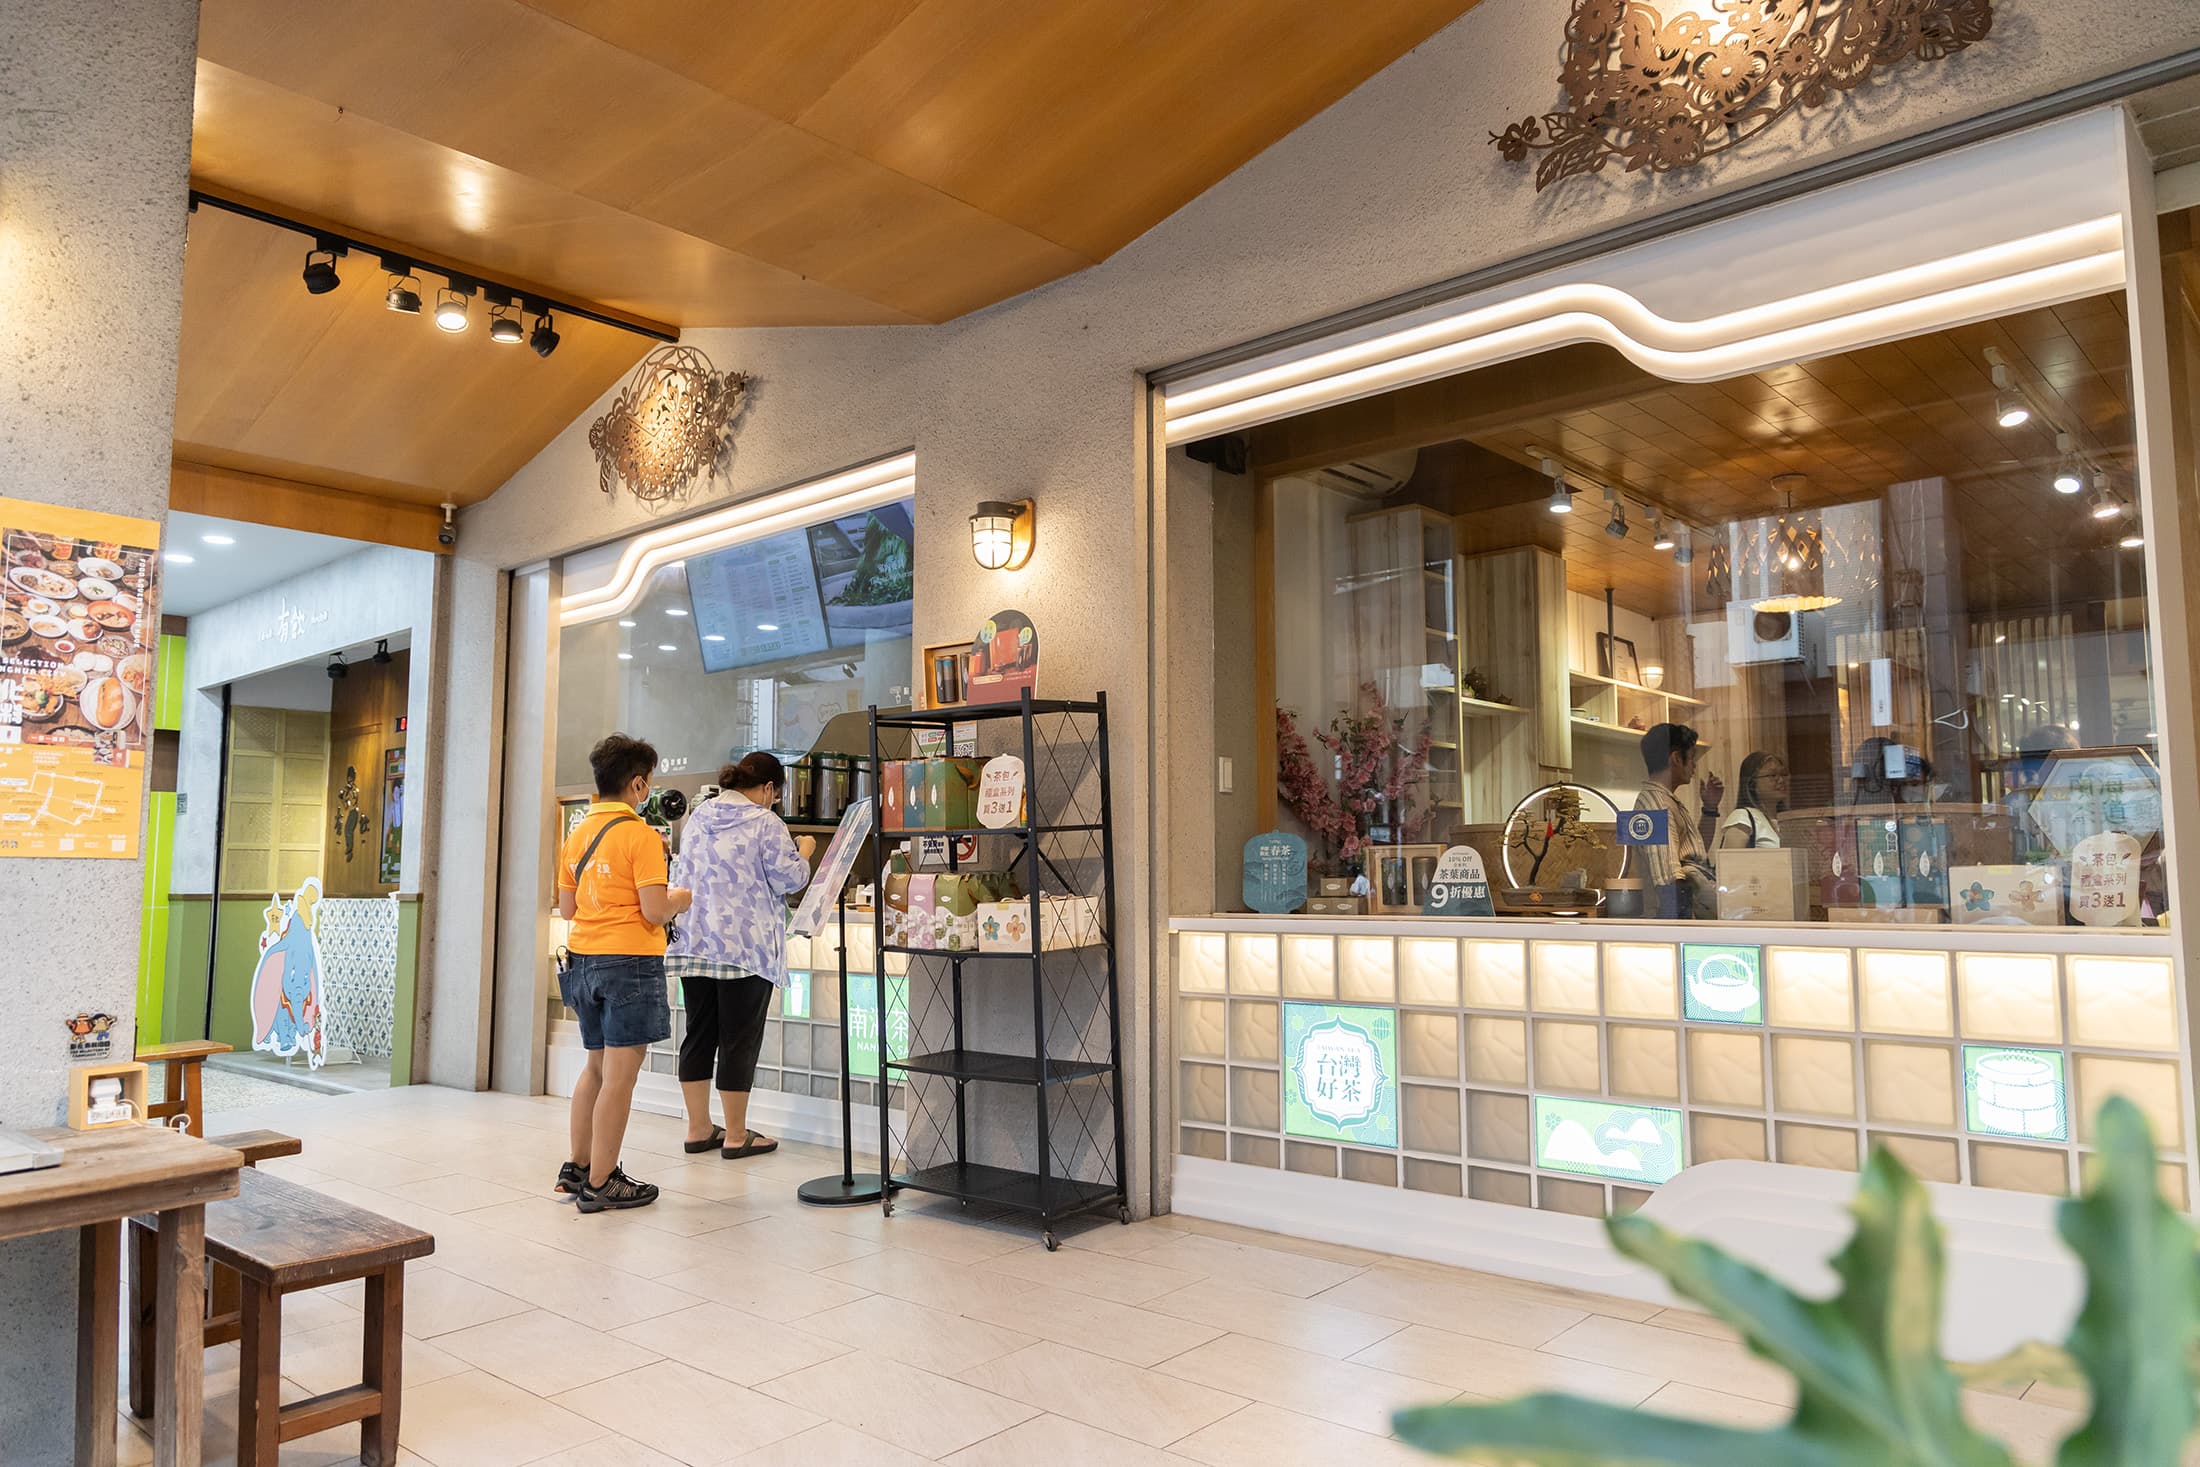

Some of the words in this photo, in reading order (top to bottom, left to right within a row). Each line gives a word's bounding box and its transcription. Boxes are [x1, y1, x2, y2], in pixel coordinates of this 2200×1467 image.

[983, 801, 1013, 815] 買3送1
[2092, 852, 2117, 868] 茶包
[1439, 867, 1480, 880] 茶葉商品
[2080, 872, 2128, 888] 禮盒系列
[2079, 891, 2127, 909] 買3送1
[1316, 1053, 1361, 1078] 台灣
[1316, 1077, 1361, 1103] 好茶
